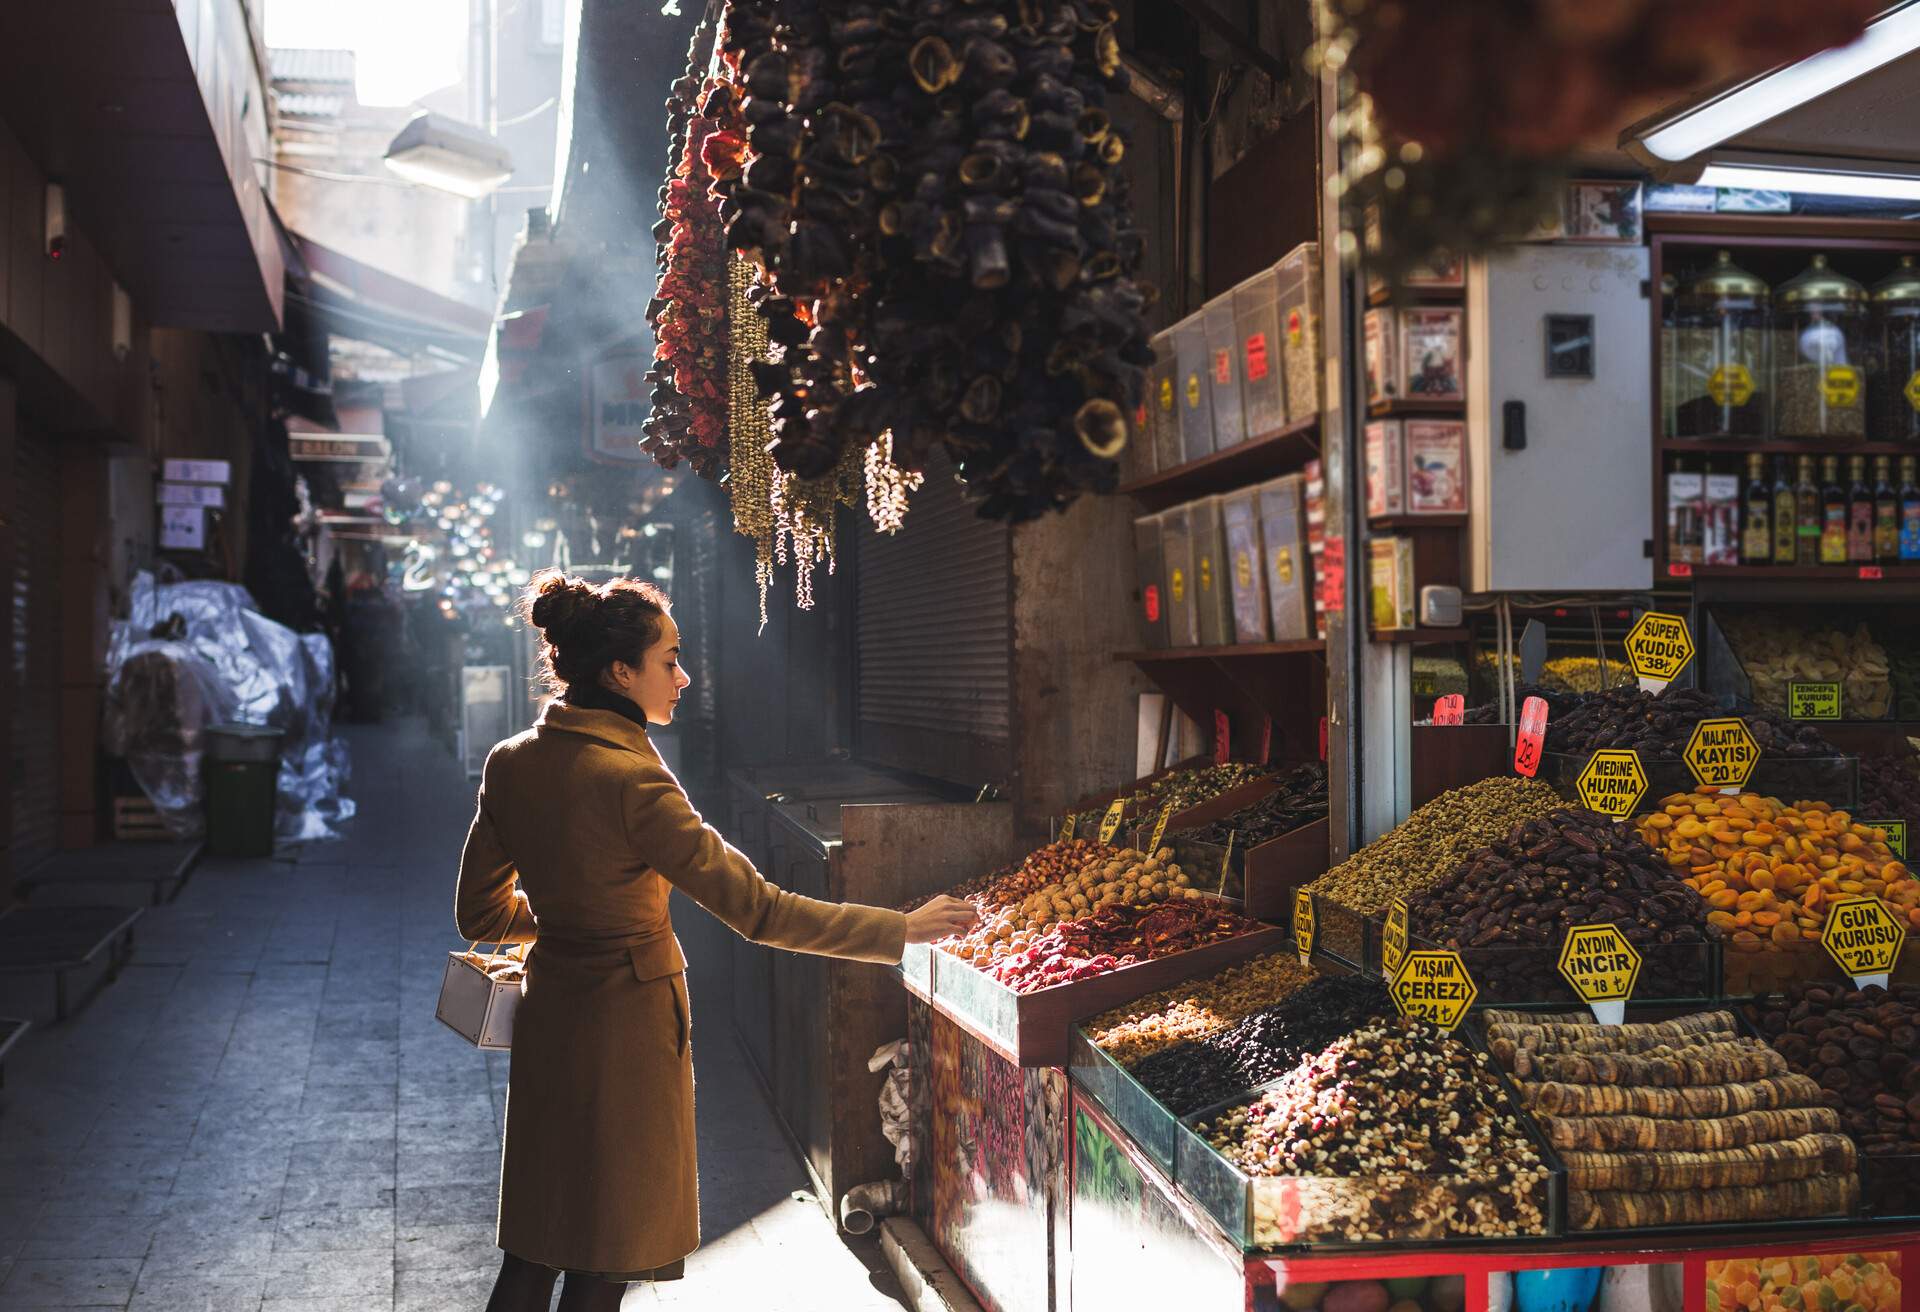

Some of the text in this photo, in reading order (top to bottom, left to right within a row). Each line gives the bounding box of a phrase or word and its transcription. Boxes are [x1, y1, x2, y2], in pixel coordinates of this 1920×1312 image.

[1644, 620, 1680, 640] SÜPER
[1635, 639, 1685, 660] KUDÜS
[1797, 693, 1834, 701] KURUSU
[1702, 729, 1744, 746] MALATYA
[1696, 746, 1751, 764] KAYISI
[1587, 778, 1637, 794] HURMA
[1840, 906, 1879, 928] GÜN
[1576, 935, 1617, 955] AYDIN
[1832, 925, 1896, 949] KURUSU
[1414, 960, 1453, 982] YAŞAM
